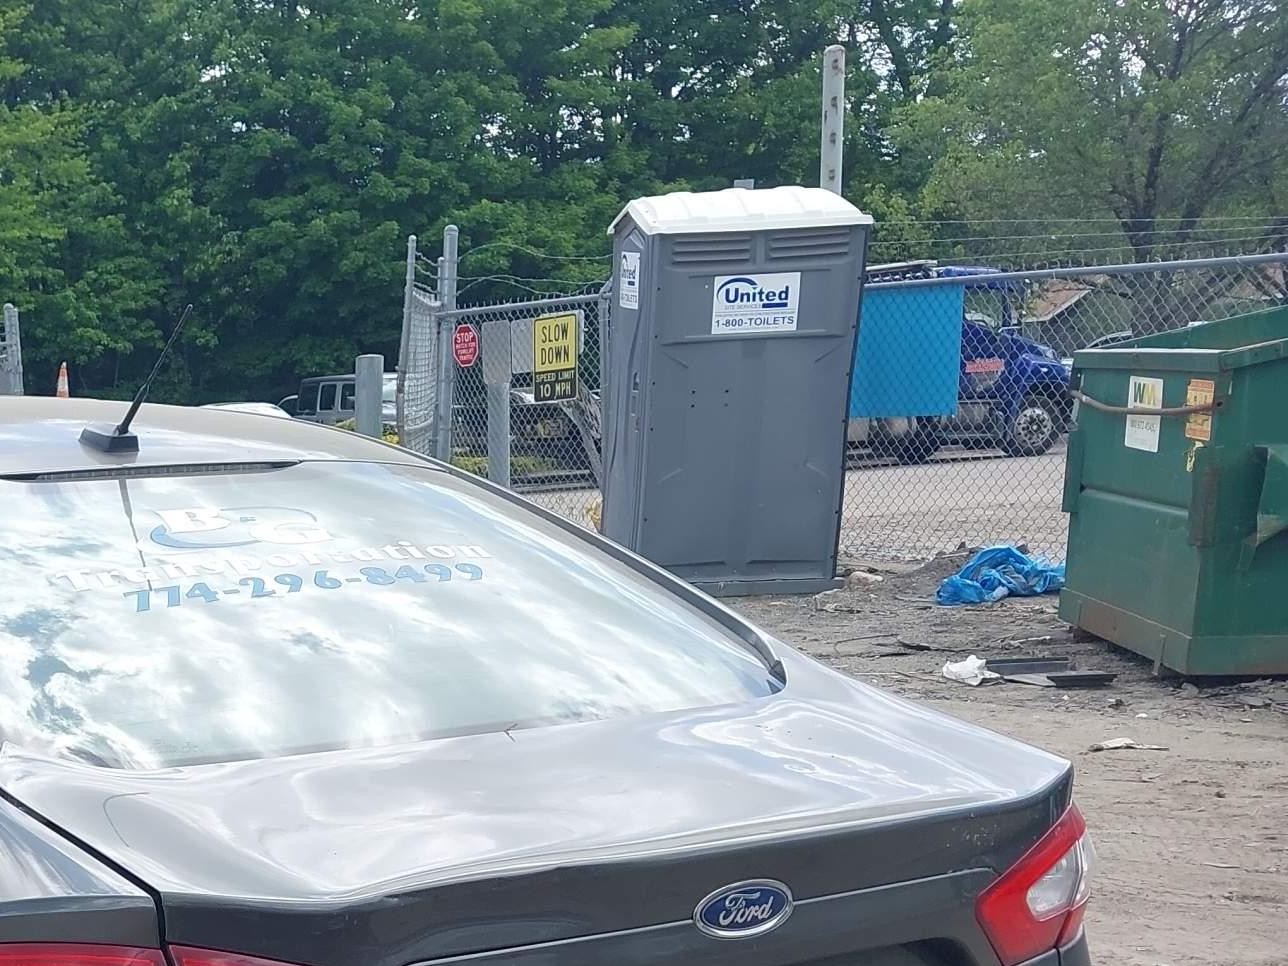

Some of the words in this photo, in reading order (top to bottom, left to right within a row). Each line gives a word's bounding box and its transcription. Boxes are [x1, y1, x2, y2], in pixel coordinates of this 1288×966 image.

[725, 285, 790, 303] United
[715, 315, 794, 328] 1-800-TOILETS
[456, 332, 473, 343] STOP
[541, 322, 569, 343] SLOW
[541, 344, 570, 366] DOWN
[536, 371, 556, 382] SPEED
[558, 369, 575, 381] LIMIT
[540, 383, 550, 397] 10
[555, 381, 571, 396] MPH
[1133, 381, 1156, 406] WM
[53, 540, 493, 592] Transportation
[122, 562, 484, 613] 774-296-8499
[718, 890, 775, 926] Ford
